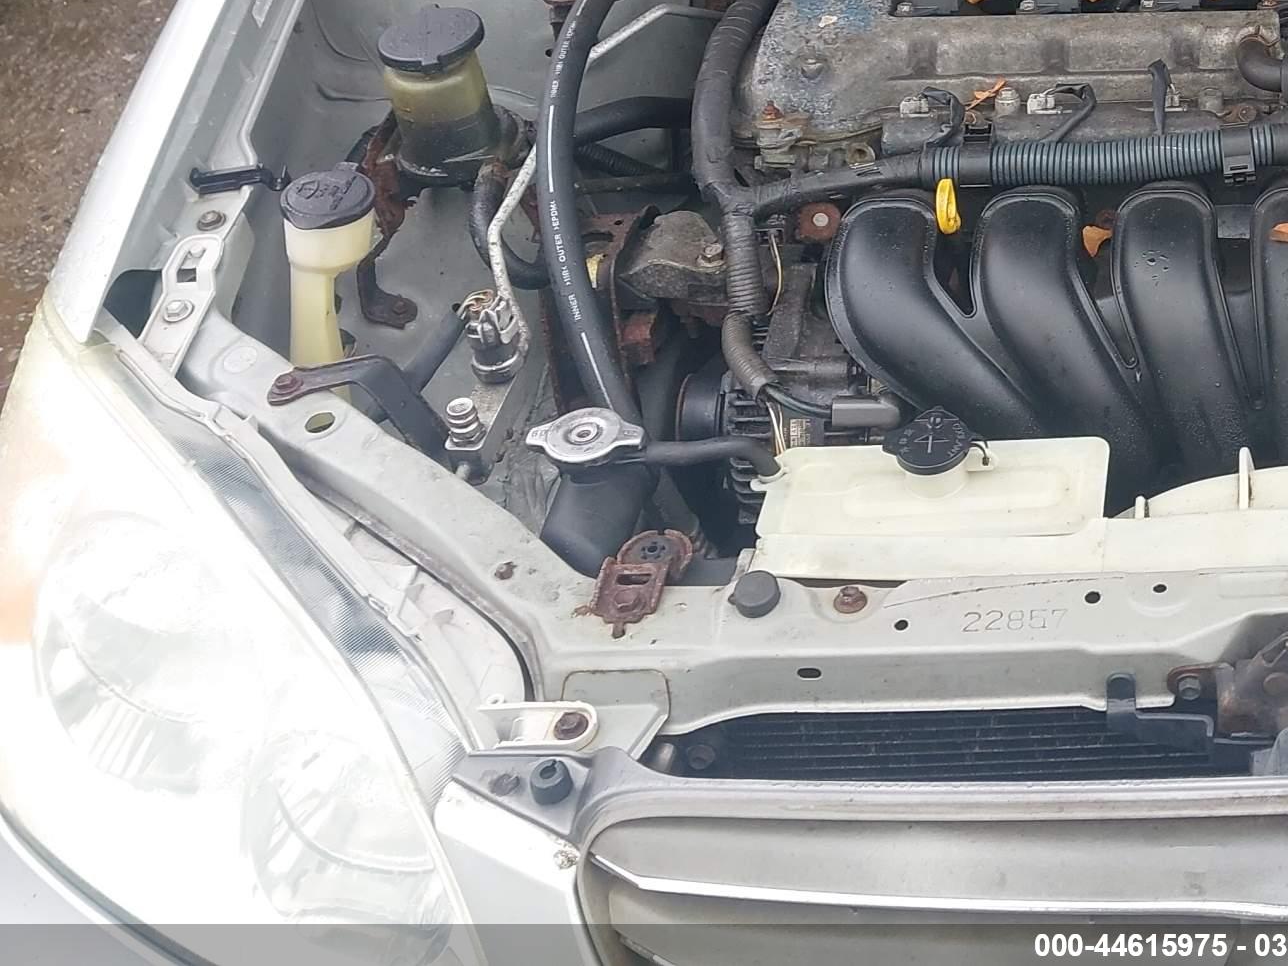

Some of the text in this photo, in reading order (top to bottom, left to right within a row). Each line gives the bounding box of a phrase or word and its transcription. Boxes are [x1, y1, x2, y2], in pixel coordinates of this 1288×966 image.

[554, 234, 566, 263] OUTER
[568, 294, 582, 322] INNER
[962, 608, 1068, 633] 22857
